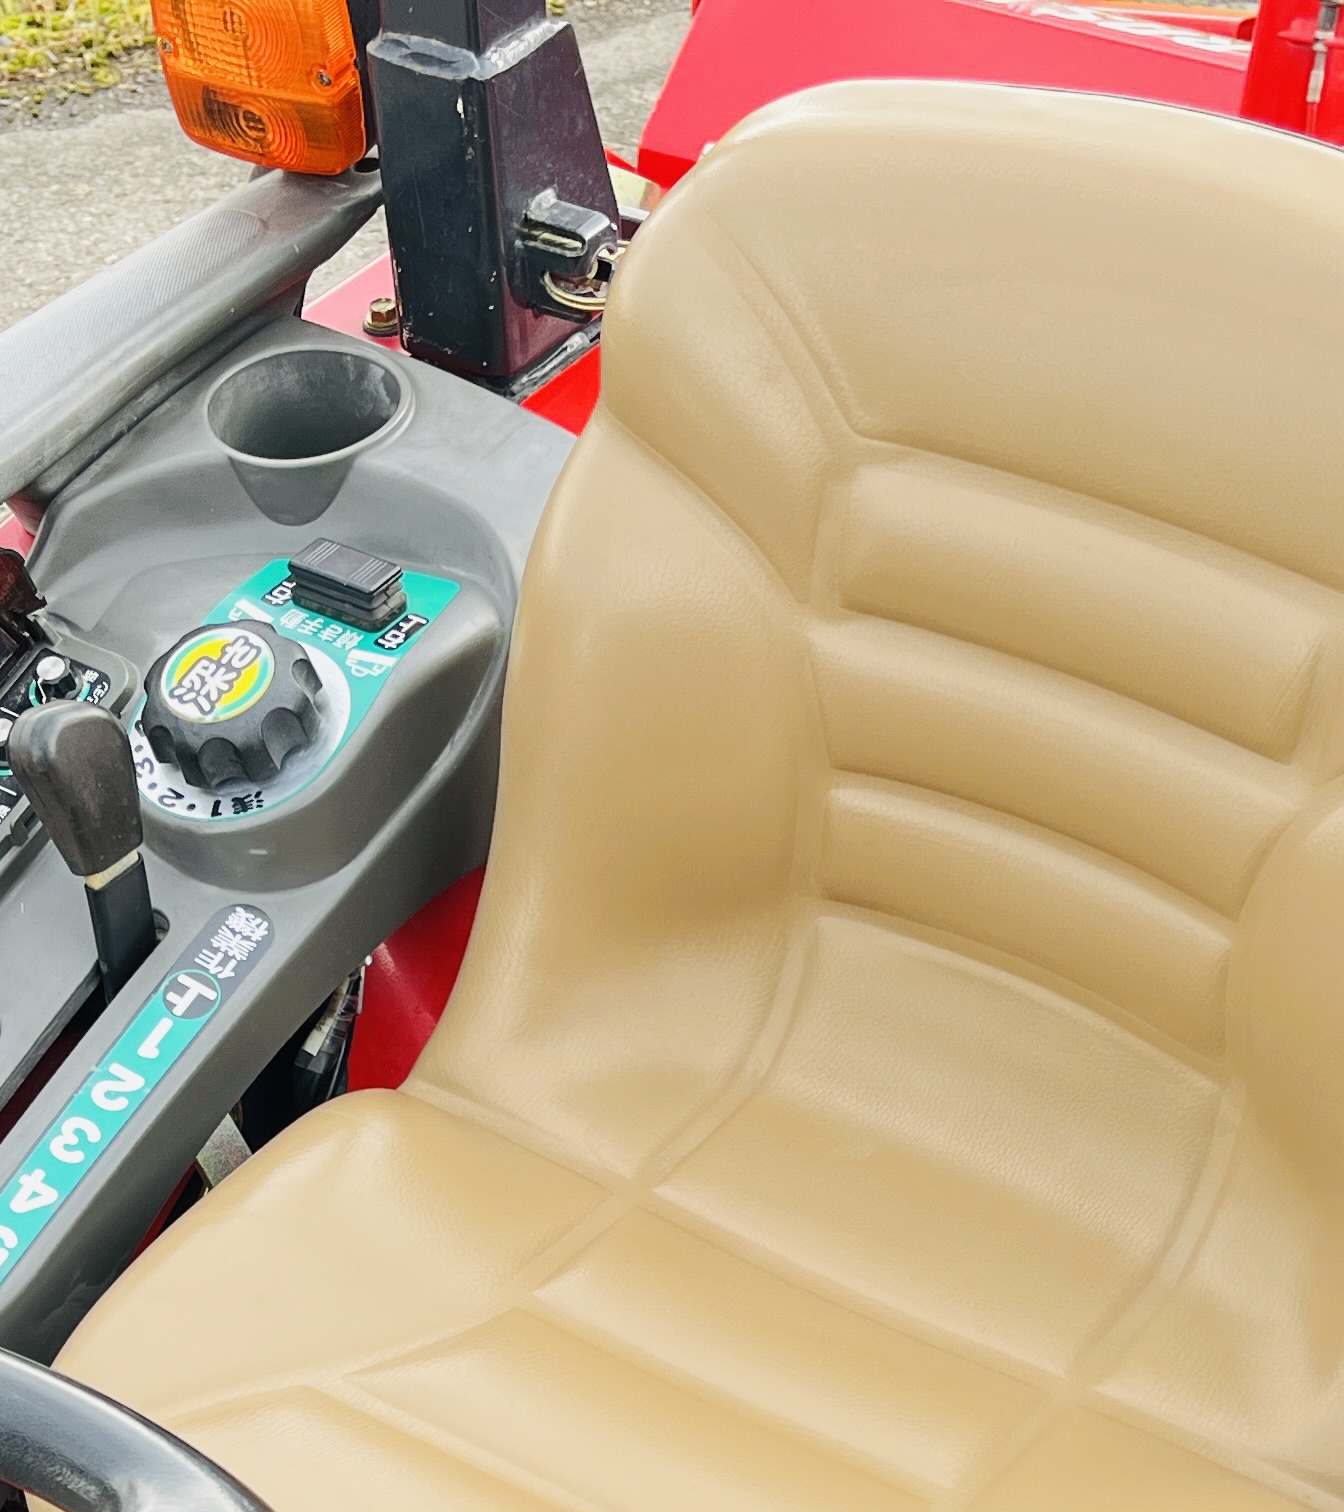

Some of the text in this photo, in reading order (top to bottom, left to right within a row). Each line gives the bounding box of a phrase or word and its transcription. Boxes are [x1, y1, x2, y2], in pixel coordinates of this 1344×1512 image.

[377, 614, 427, 650] 右上
[171, 636, 260, 714] 深さ
[158, 787, 185, 808] 2
[210, 798, 223, 818] 1
[231, 790, 264, 815] 浅
[193, 905, 270, 979] 作業機
[162, 972, 219, 1018] 上
[136, 1018, 175, 1060] 1
[90, 1063, 147, 1112] 2
[49, 1119, 102, 1164] 3
[9, 1169, 59, 1214] 4
